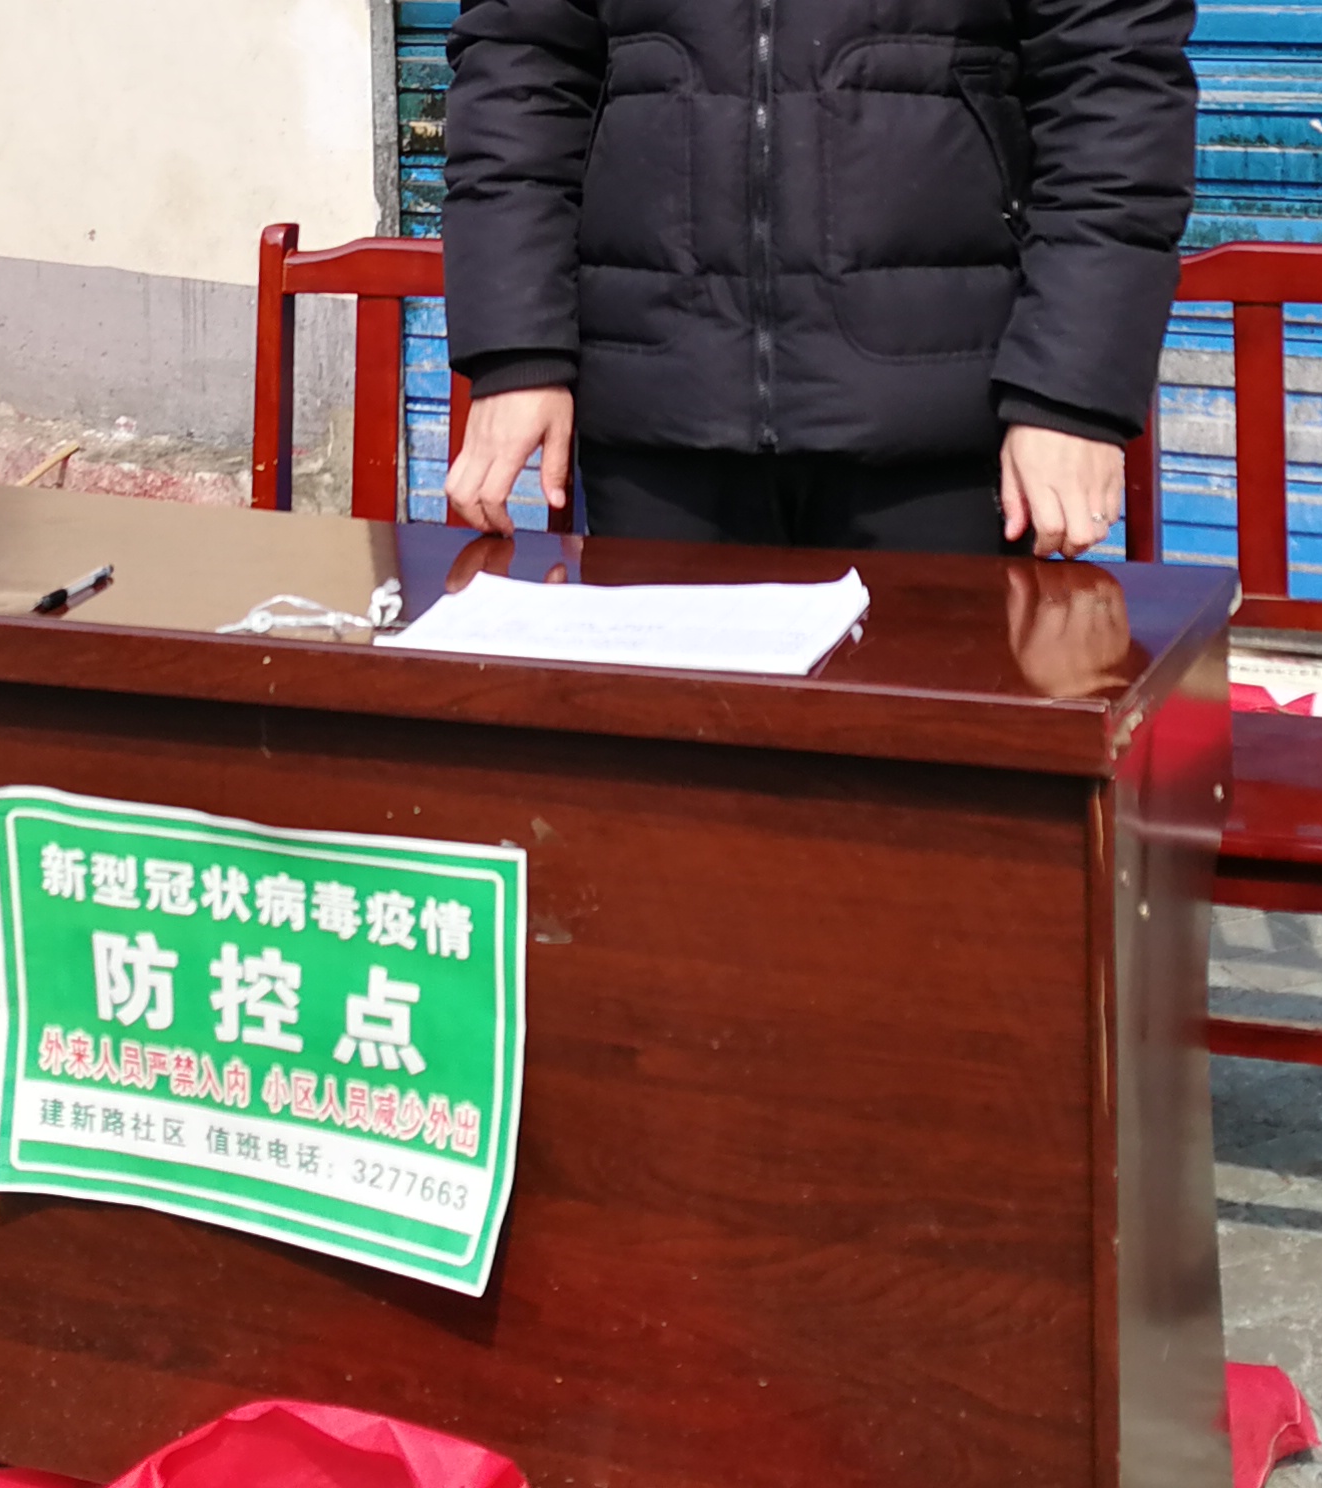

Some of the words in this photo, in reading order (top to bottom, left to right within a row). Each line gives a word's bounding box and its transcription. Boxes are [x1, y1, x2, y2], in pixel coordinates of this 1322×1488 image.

[40, 842, 474, 960] 新型冠状病毒疫情
[91, 930, 427, 1075] 防控点
[38, 1026, 251, 1109] 外来人员严禁入内
[261, 1065, 480, 1157] 小区人员减少外出
[40, 1098, 187, 1149] 建新路社区
[352, 1158, 470, 1212] 3277663
